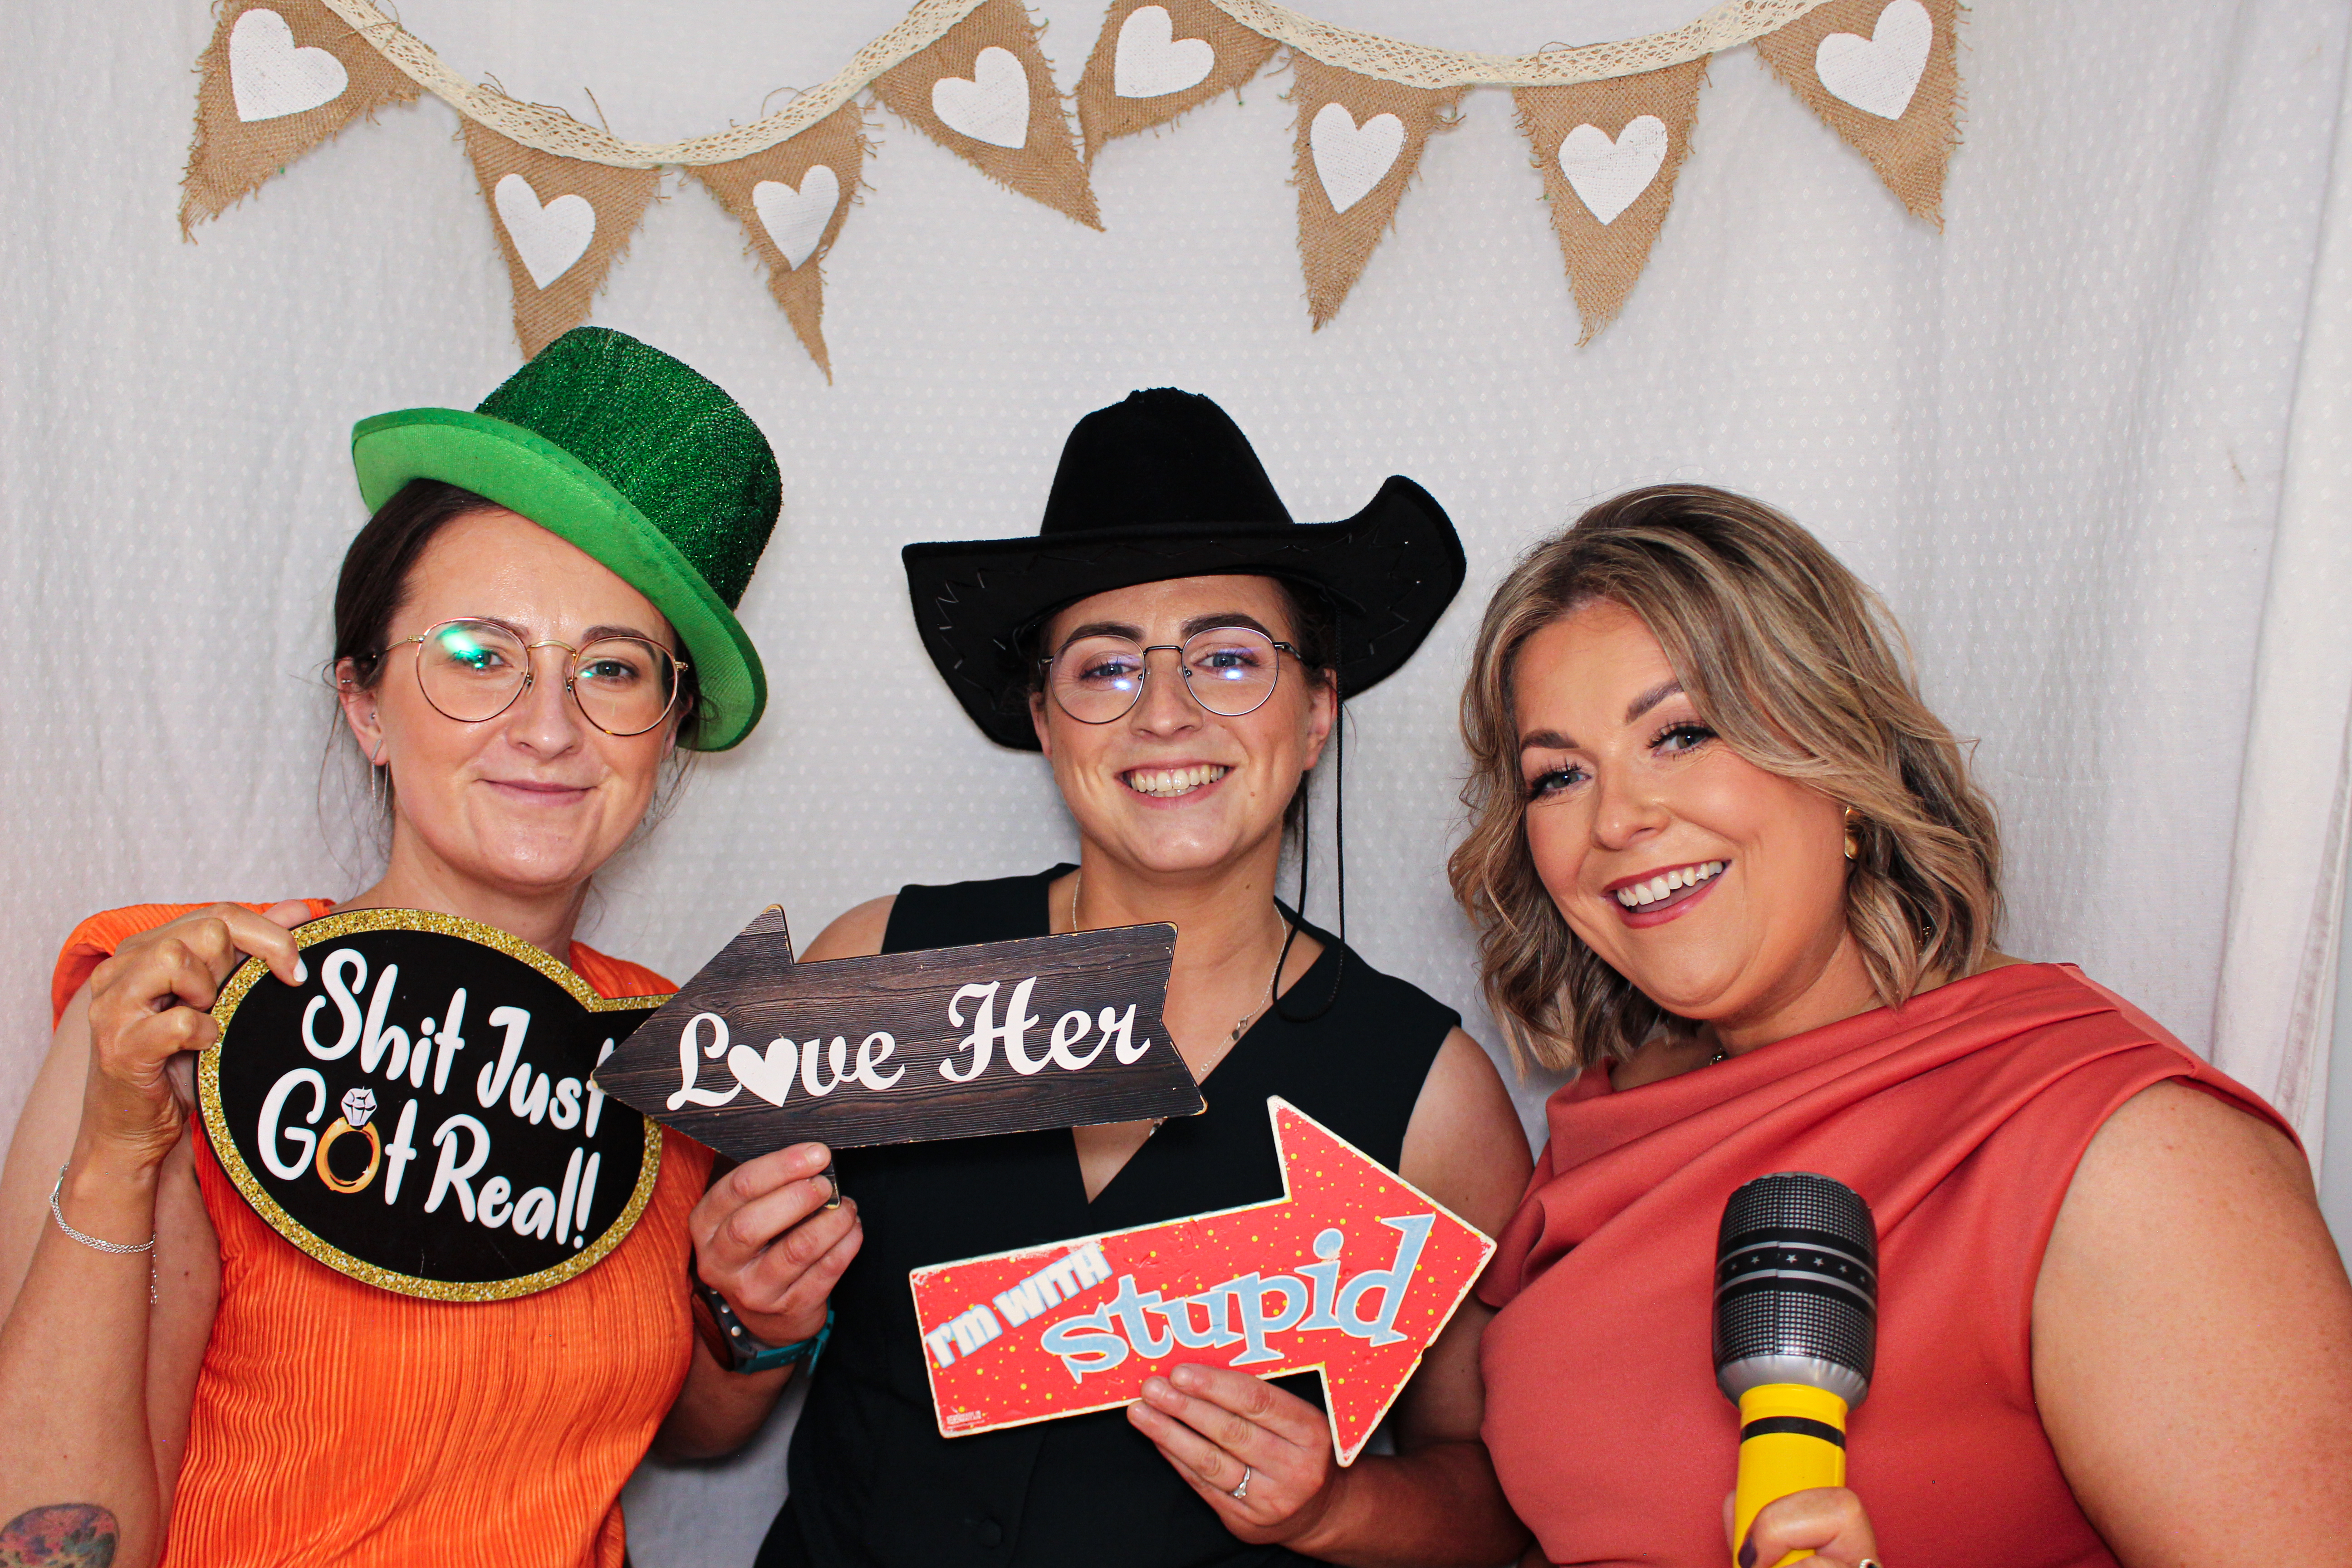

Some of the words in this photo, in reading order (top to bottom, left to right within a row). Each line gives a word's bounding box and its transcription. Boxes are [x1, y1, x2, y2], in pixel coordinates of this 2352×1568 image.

[301, 947, 467, 1095] Shit
[938, 975, 1151, 1083] Her
[991, 1241, 1113, 1328] WITH
[1040, 1213, 1436, 1384] stupid
